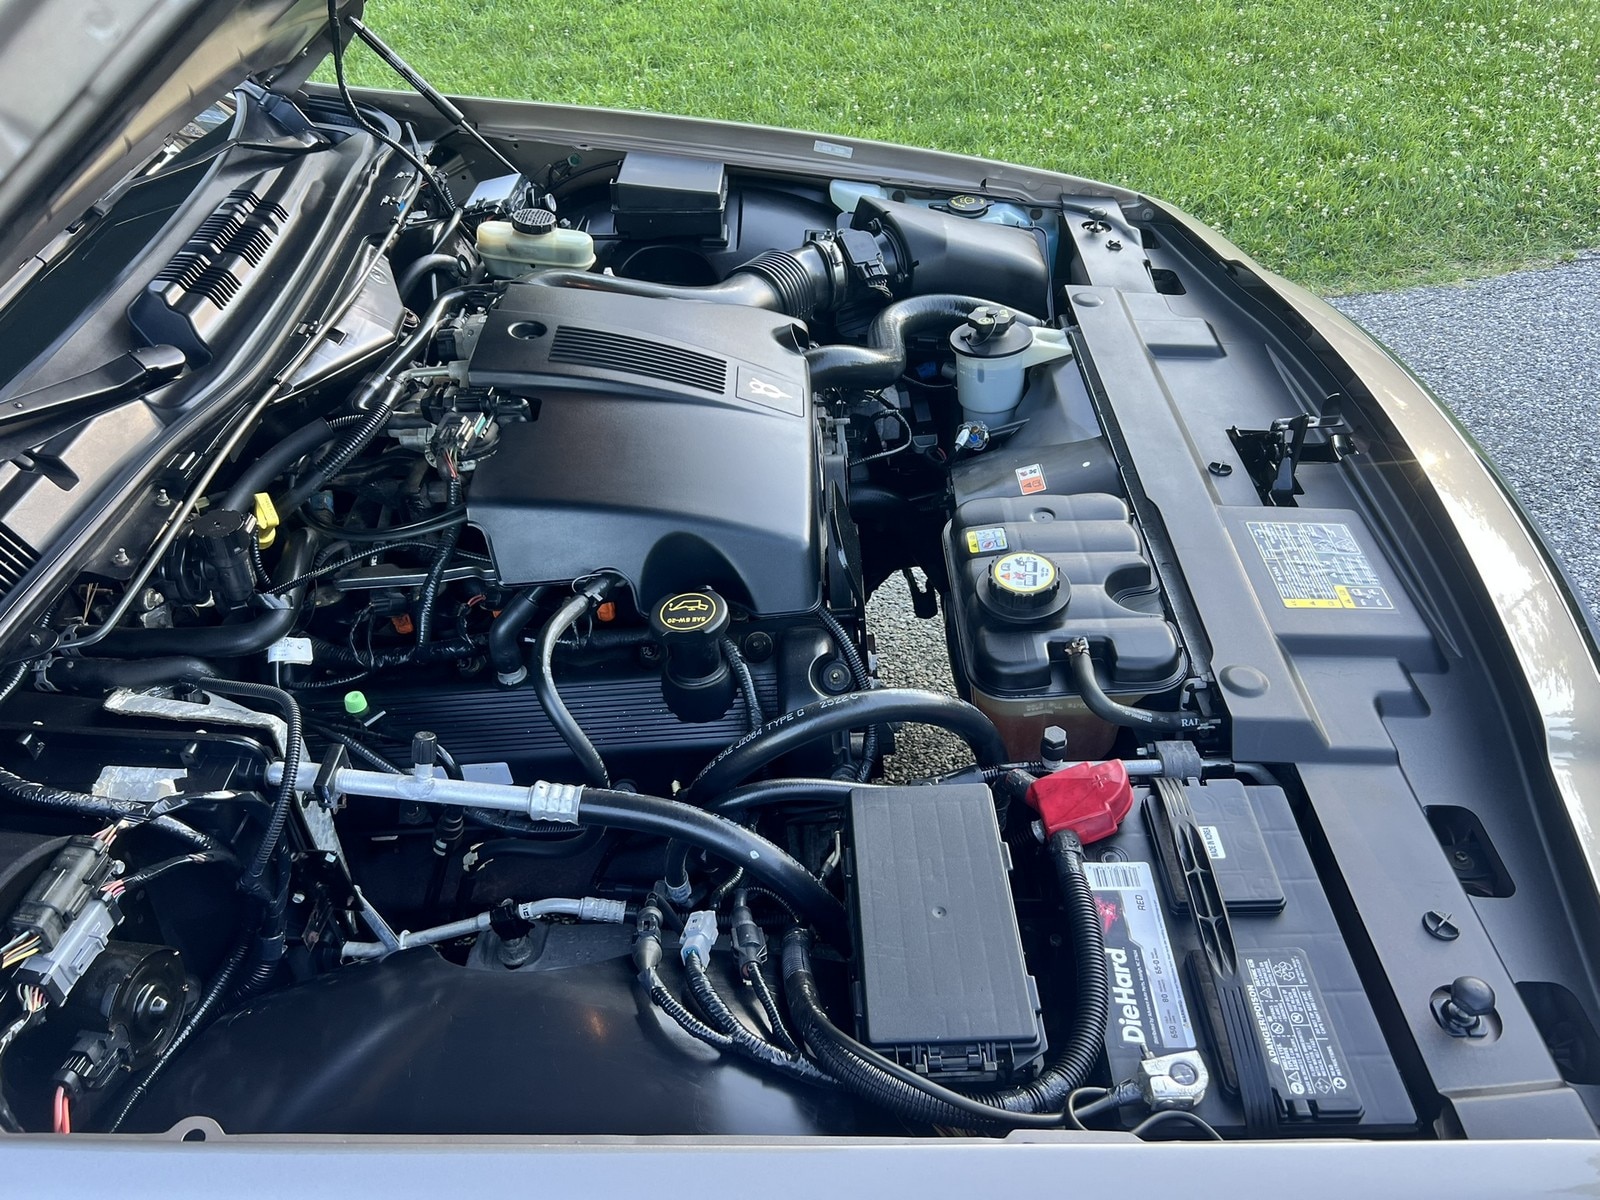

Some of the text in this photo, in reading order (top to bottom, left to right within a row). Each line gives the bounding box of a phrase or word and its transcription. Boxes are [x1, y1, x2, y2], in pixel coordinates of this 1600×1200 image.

[717, 745, 734, 761] SAE
[765, 712, 794, 730] TYPE
[1134, 894, 1146, 910] RED
[1105, 947, 1146, 1044] DieHard
[1160, 993, 1169, 1002] 80
[1168, 1025, 1178, 1038] 650
[1247, 984, 1276, 1057] DANGER/POISON
